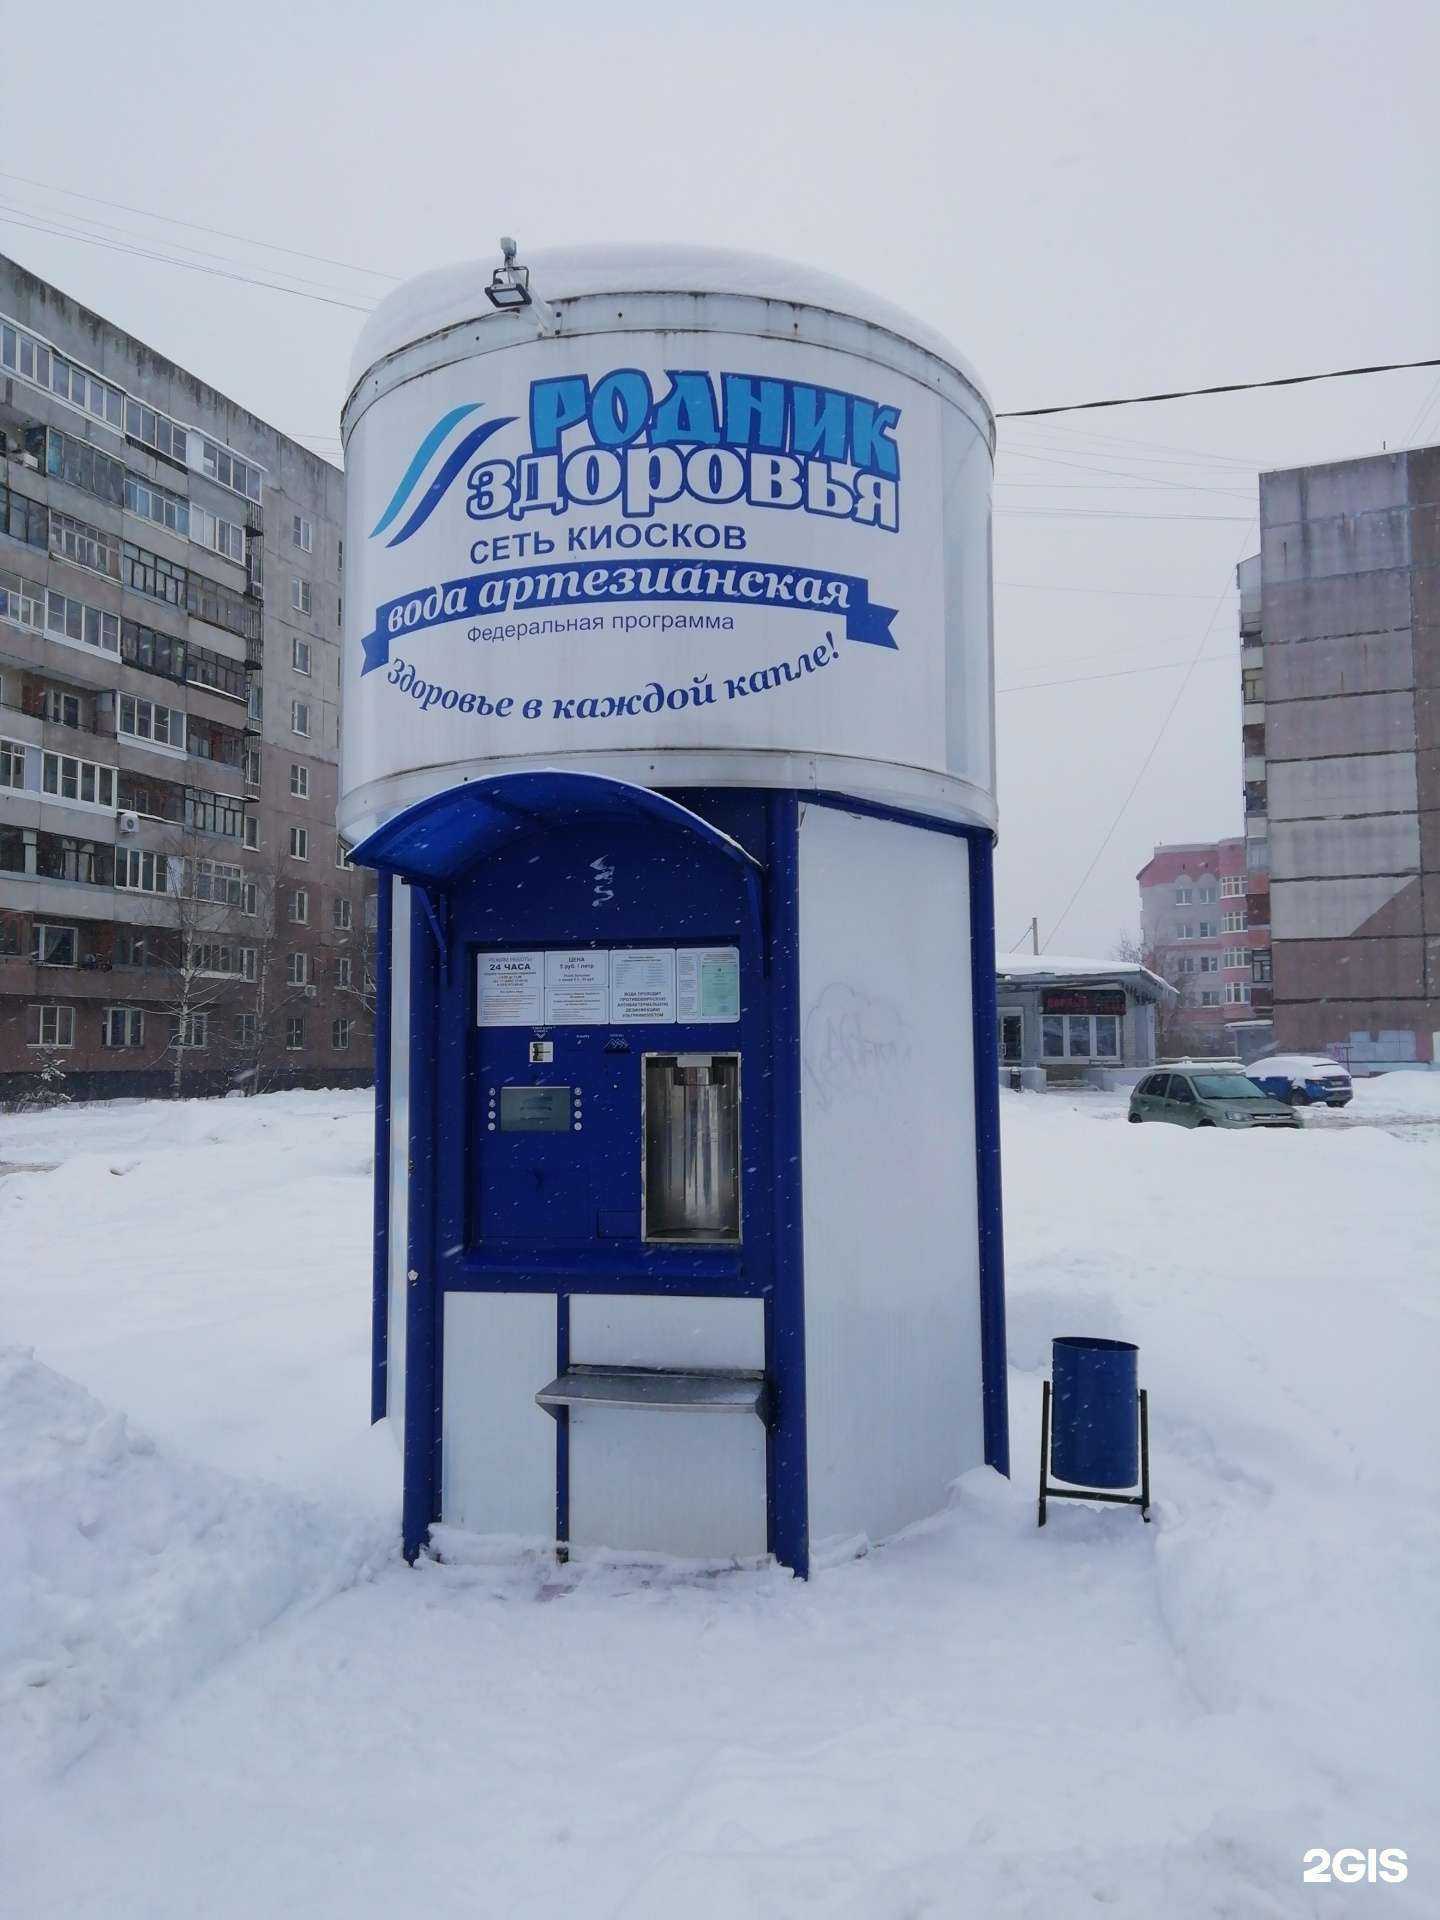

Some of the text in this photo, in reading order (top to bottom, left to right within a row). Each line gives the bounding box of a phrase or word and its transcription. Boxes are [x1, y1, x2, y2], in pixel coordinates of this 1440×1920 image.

[529, 367, 902, 477] РОДНИК
[470, 523, 747, 564] СЕТЬ КИОСКОВ
[387, 562, 851, 633] вода артезианская
[466, 613, 735, 643] Федеральная программа
[386, 630, 841, 720] Здоровье в каждой капле!
